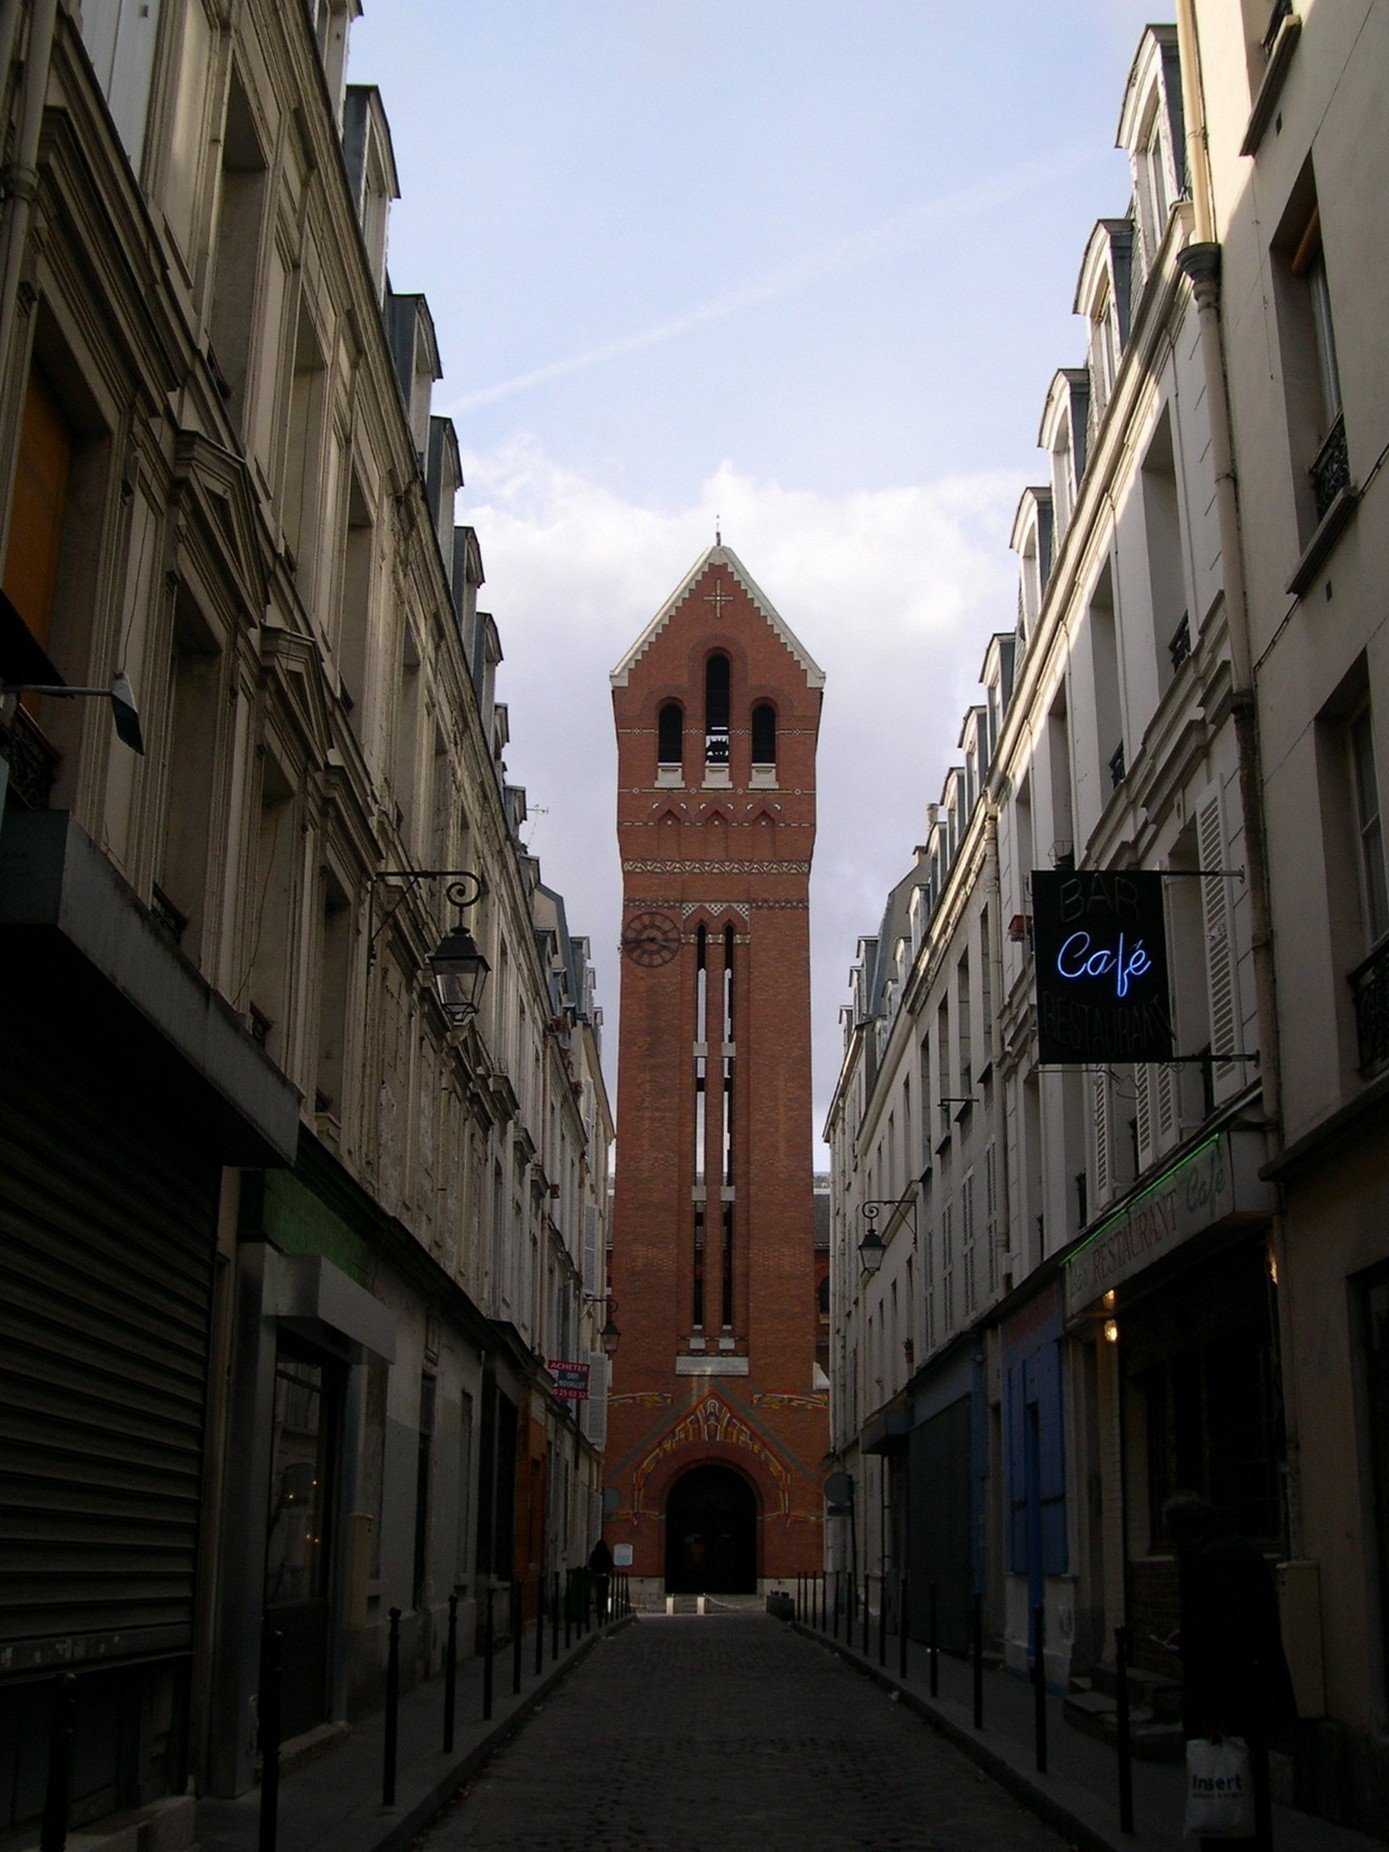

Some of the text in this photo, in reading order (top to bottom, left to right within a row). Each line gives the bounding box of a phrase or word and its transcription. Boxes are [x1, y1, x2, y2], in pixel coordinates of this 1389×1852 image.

[1059, 873, 1140, 924] BAR
[1056, 931, 1153, 998] Café
[1091, 1188, 1178, 1283] RESTAURANT
[1186, 1149, 1227, 1218] Café
